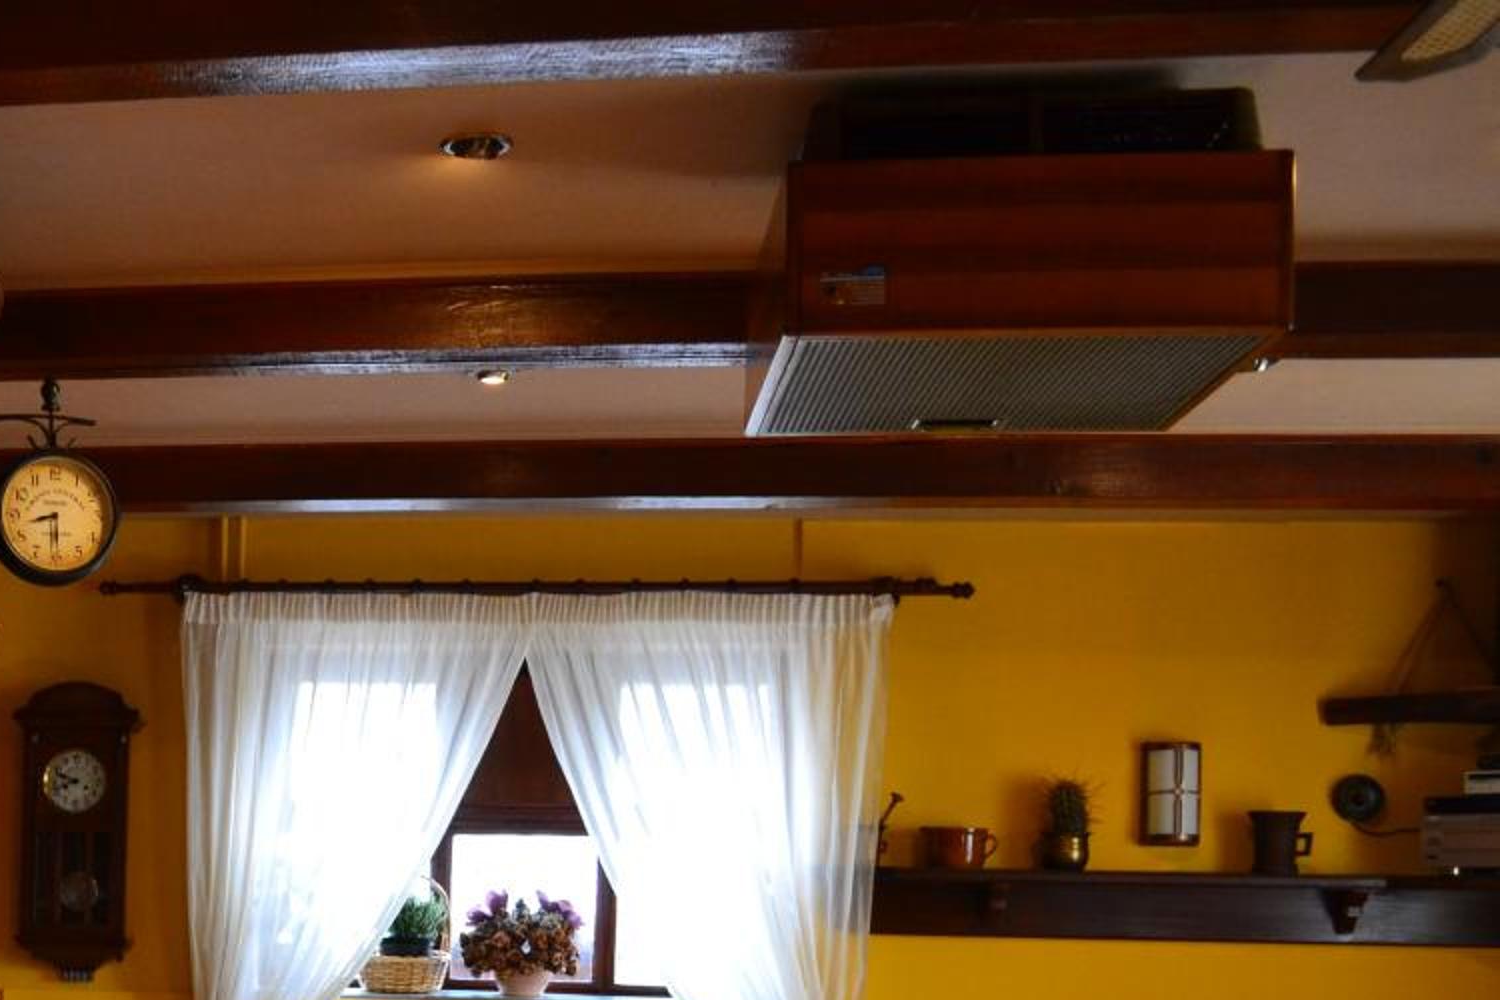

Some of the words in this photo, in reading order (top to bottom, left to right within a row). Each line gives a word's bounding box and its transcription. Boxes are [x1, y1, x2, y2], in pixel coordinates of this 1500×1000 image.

[31, 473, 40, 487] 11
[49, 468, 61, 481] 12
[15, 487, 29, 502] 10
